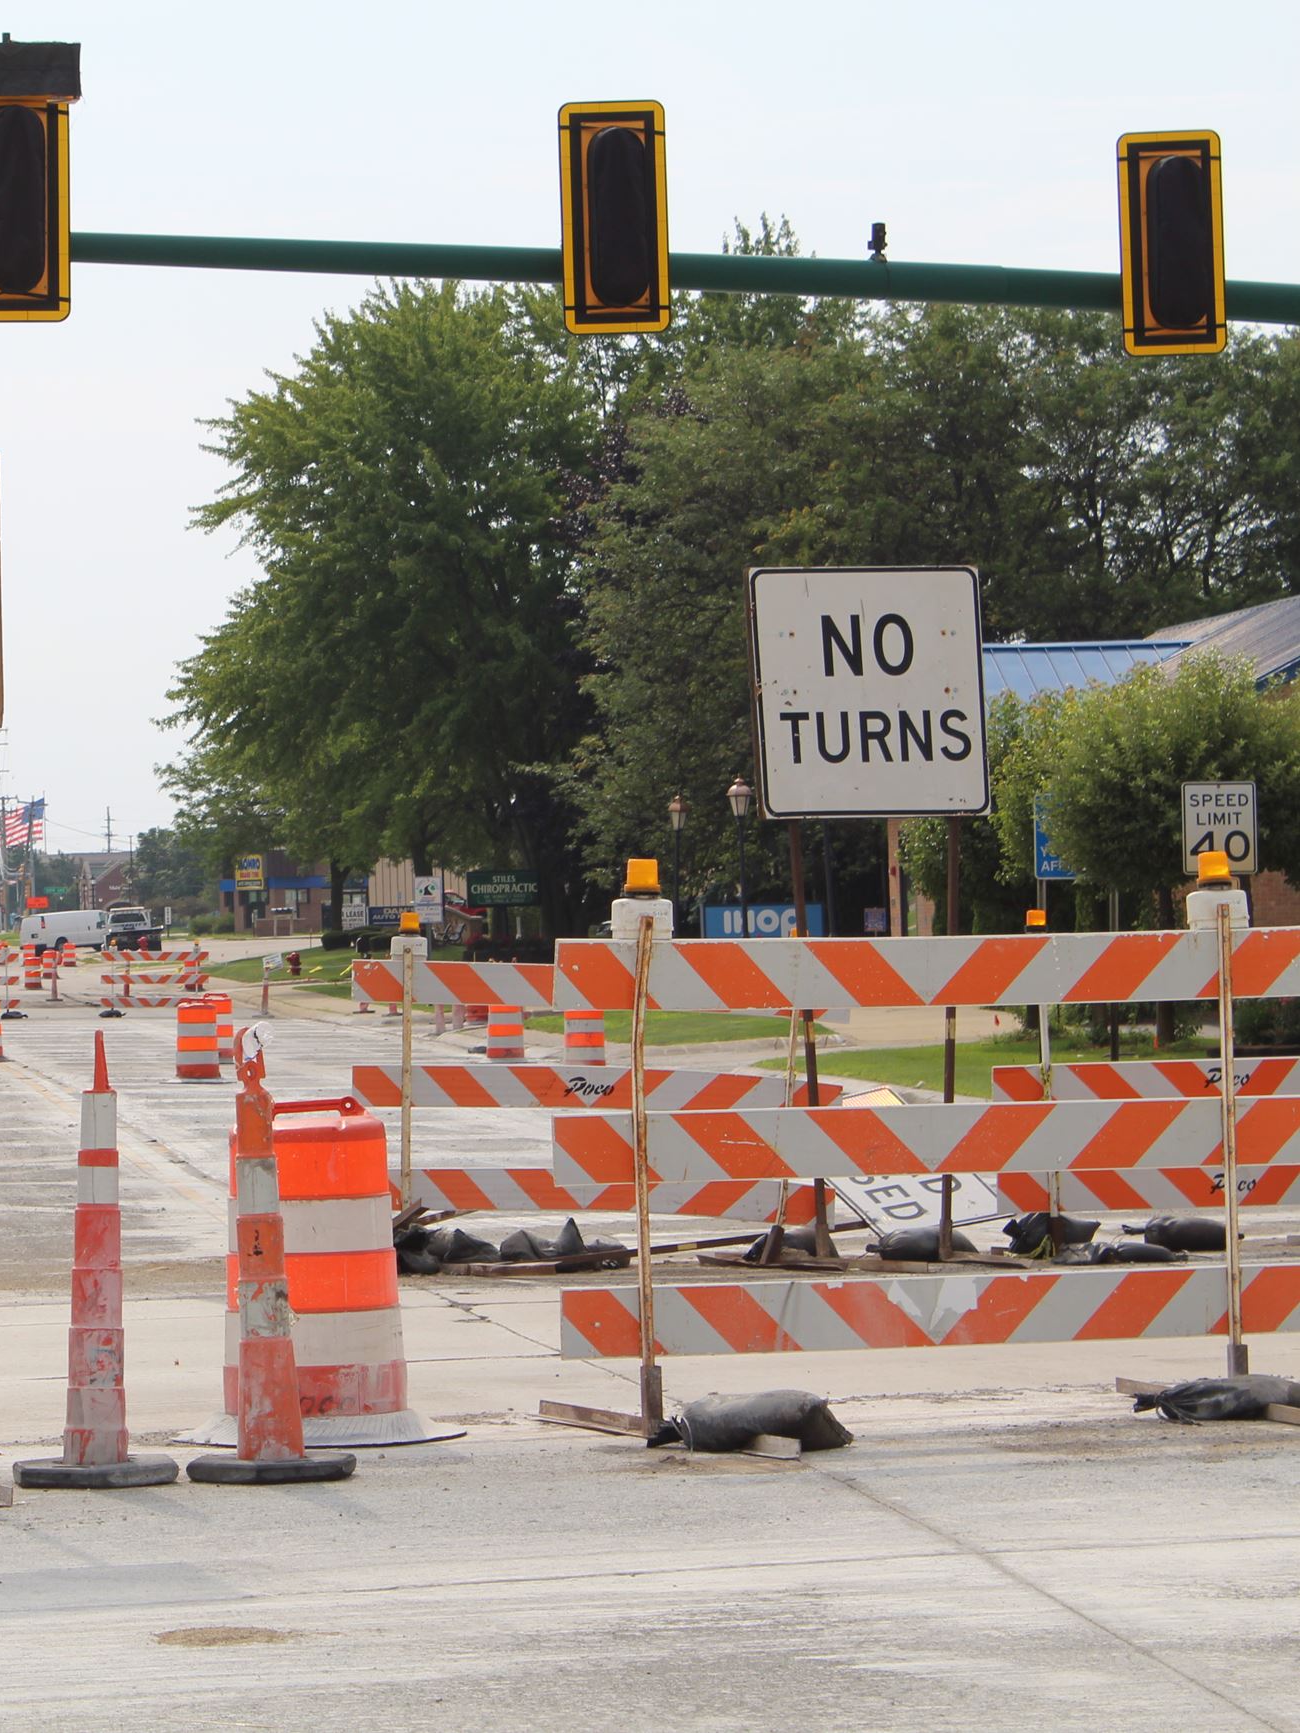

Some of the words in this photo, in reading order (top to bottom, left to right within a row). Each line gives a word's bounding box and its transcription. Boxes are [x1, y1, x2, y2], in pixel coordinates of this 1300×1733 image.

[820, 612, 914, 678] NO
[779, 708, 973, 765] TURNS
[1189, 793, 1249, 807] SPEED
[1196, 812, 1242, 826] LIMIT
[1190, 830, 1250, 862] 40
[470, 882, 539, 895] CHIROPRACTIC
[492, 874, 516, 883] STILES
[345, 910, 364, 919] LEASE
[723, 908, 797, 937] IHOP
[563, 1076, 615, 1098] Poco
[1204, 1067, 1250, 1089] Pco
[1210, 1173, 1257, 1195] Pco
